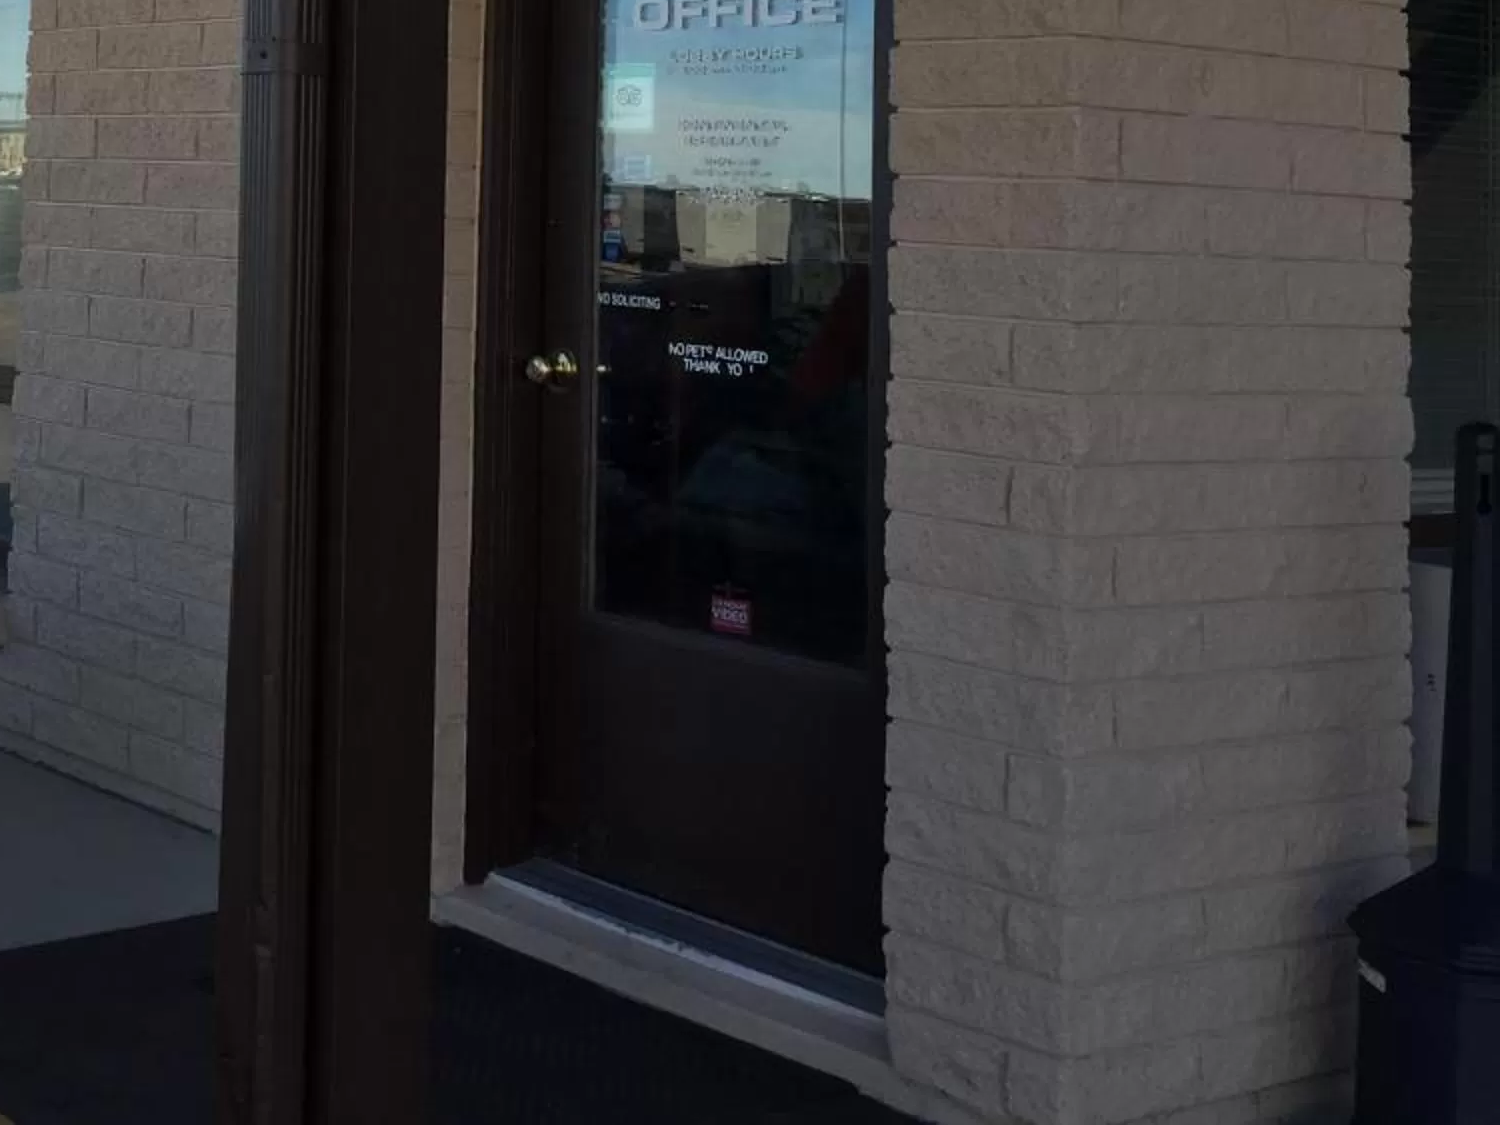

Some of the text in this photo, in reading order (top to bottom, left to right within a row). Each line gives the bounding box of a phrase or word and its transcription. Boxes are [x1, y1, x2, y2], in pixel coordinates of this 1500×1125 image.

[596, 292, 661, 310] NO SOLICITING
[668, 342, 685, 356] NO
[715, 347, 769, 364] ALLOWED
[683, 358, 721, 375] THANK
